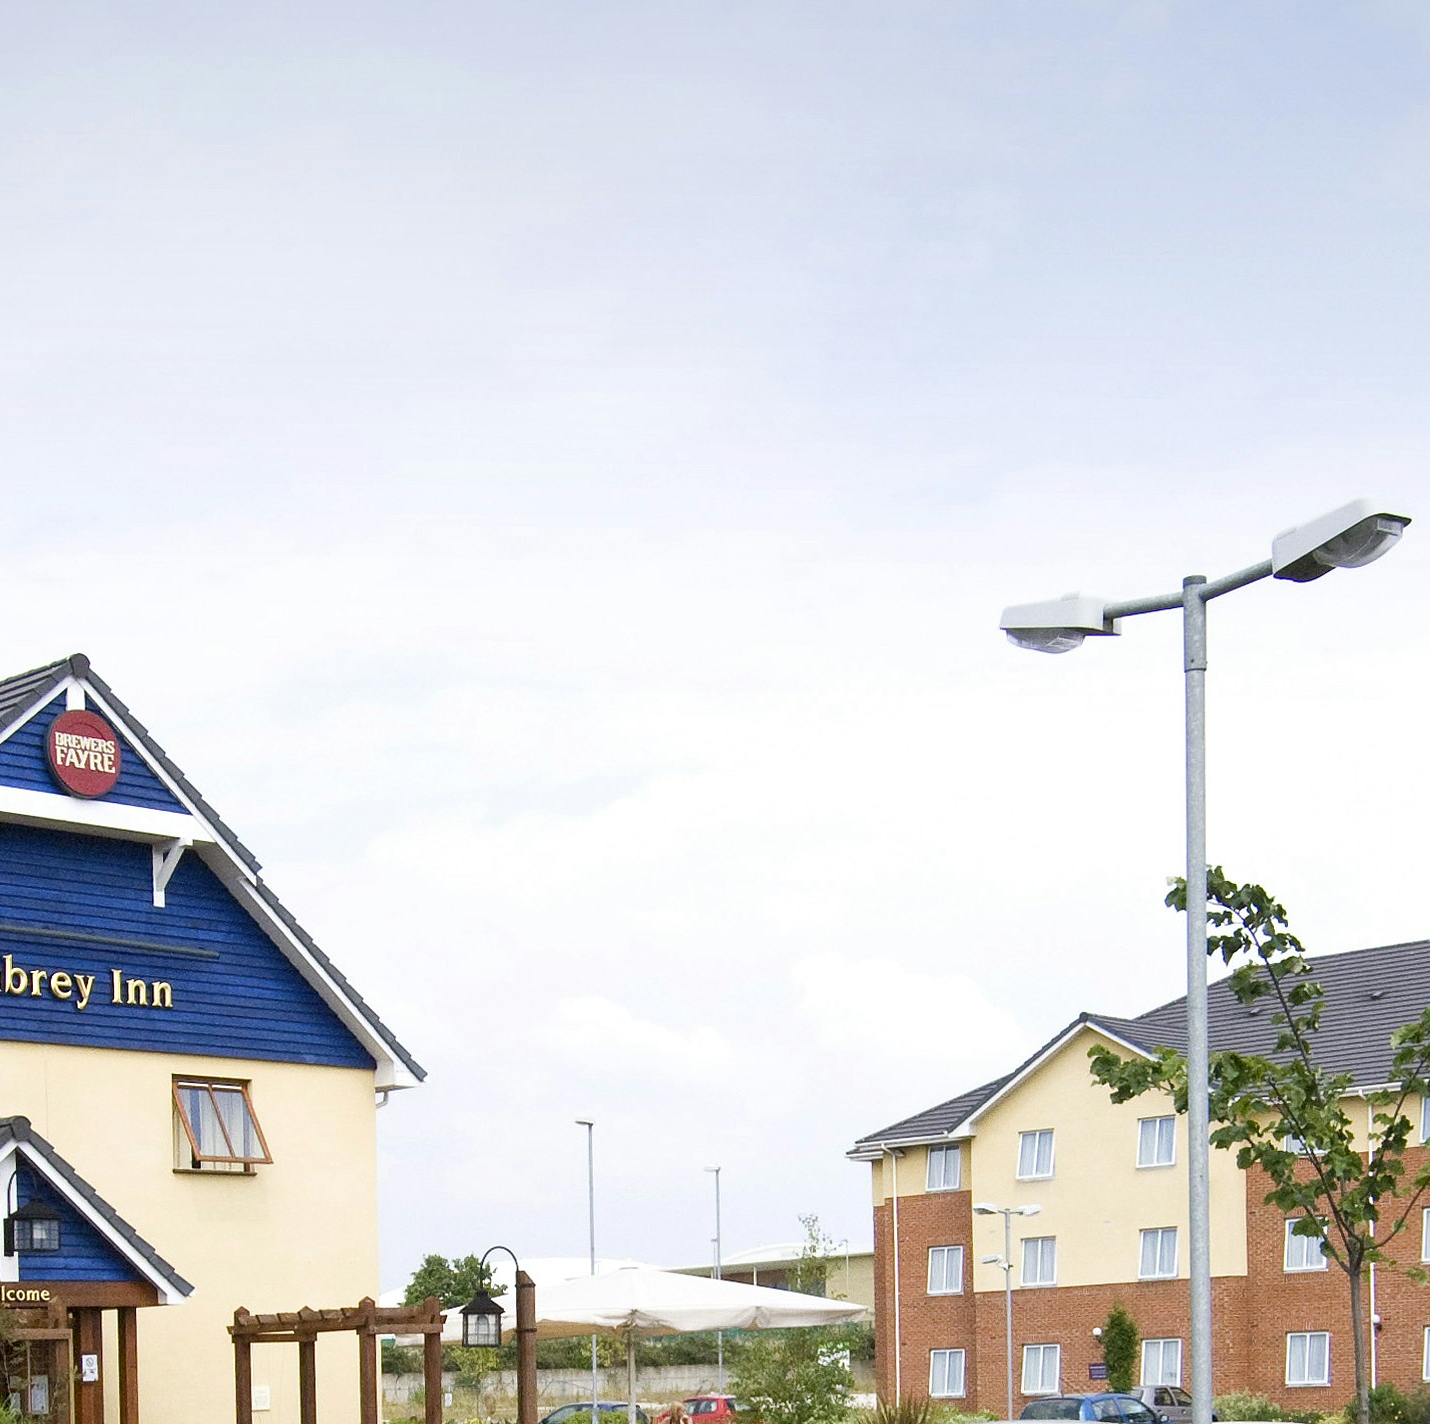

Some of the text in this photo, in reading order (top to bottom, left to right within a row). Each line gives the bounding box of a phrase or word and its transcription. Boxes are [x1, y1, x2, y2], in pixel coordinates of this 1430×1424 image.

[55, 731, 115, 754] BREWERS
[55, 746, 116, 774] FAYRE
[111, 969, 173, 1008] Inn
